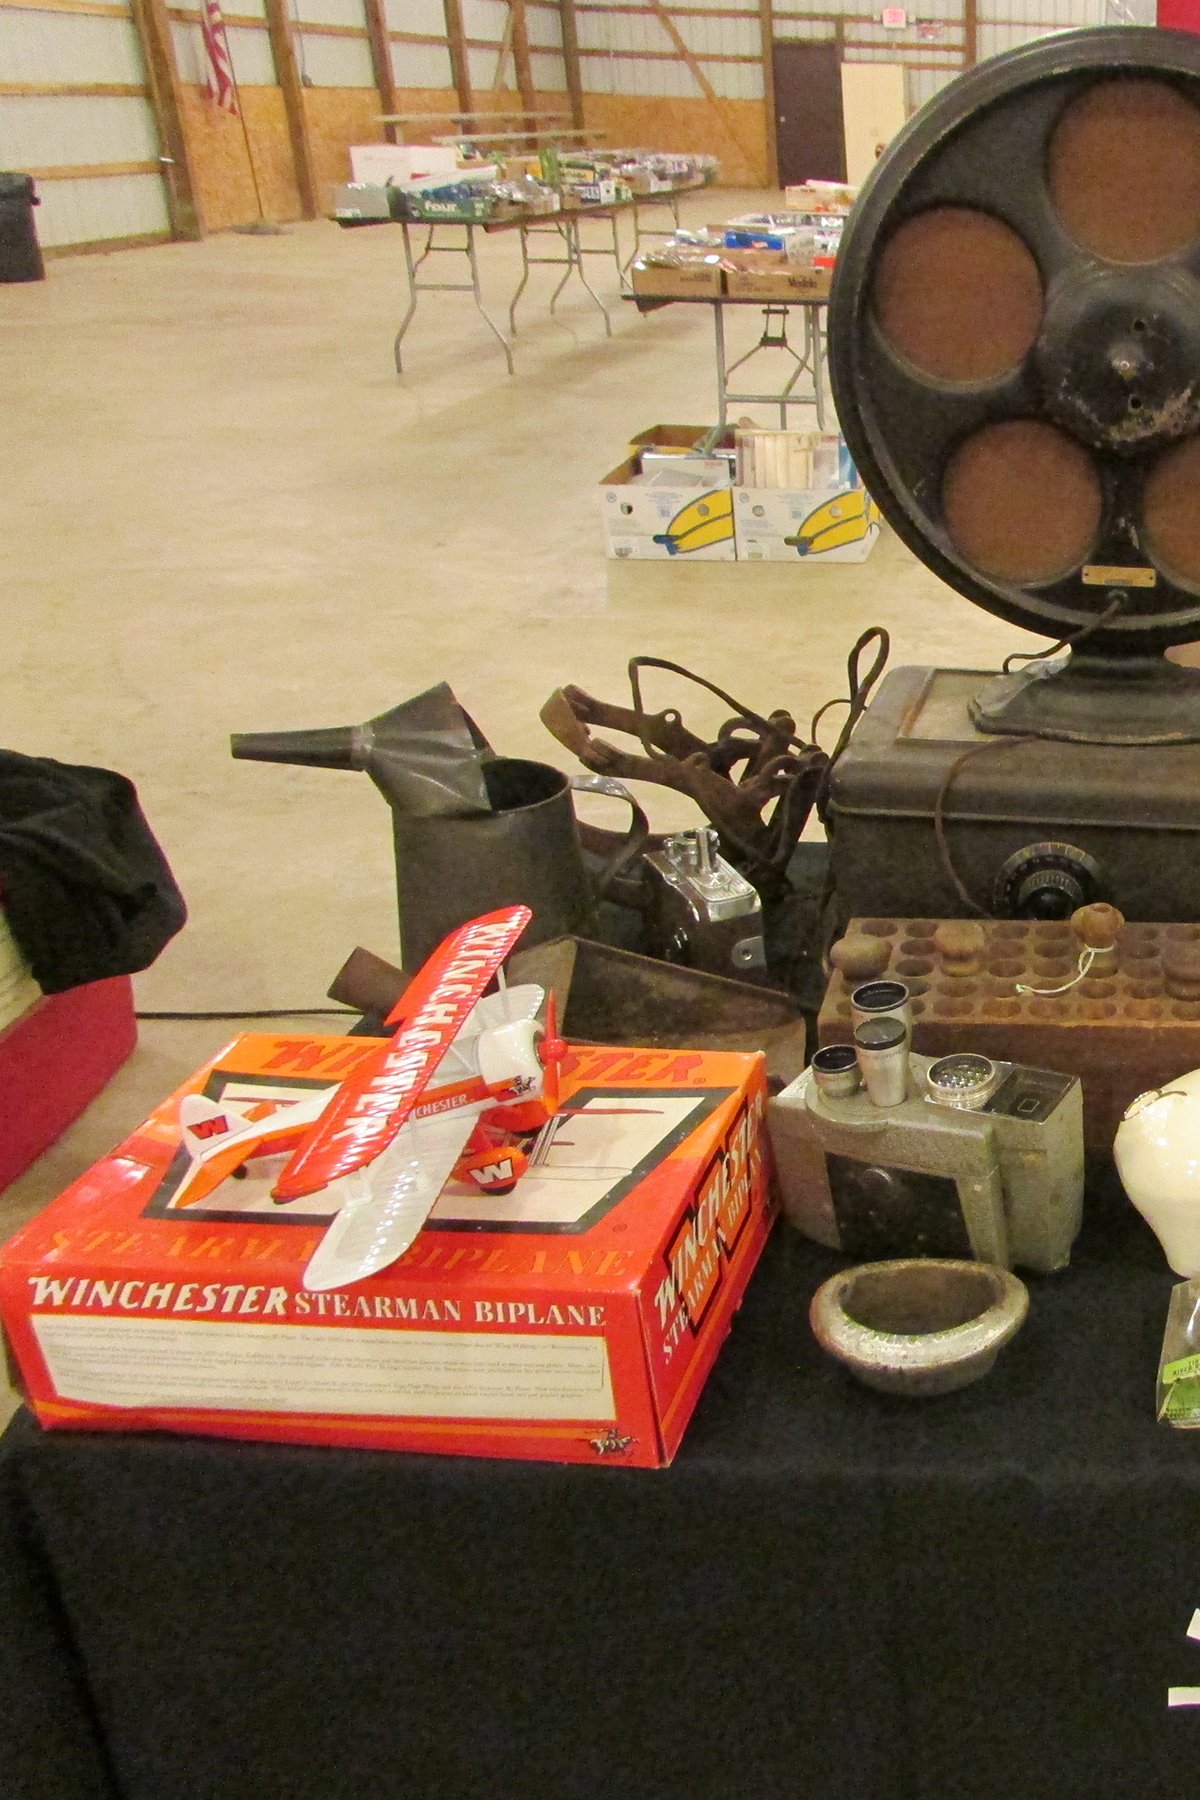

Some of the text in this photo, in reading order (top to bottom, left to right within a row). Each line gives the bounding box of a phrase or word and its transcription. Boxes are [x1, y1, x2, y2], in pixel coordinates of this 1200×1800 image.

[467, 1157, 515, 1185] W
[26, 1275, 608, 1327] WINCHESTER STEARMAN BIPLANE
